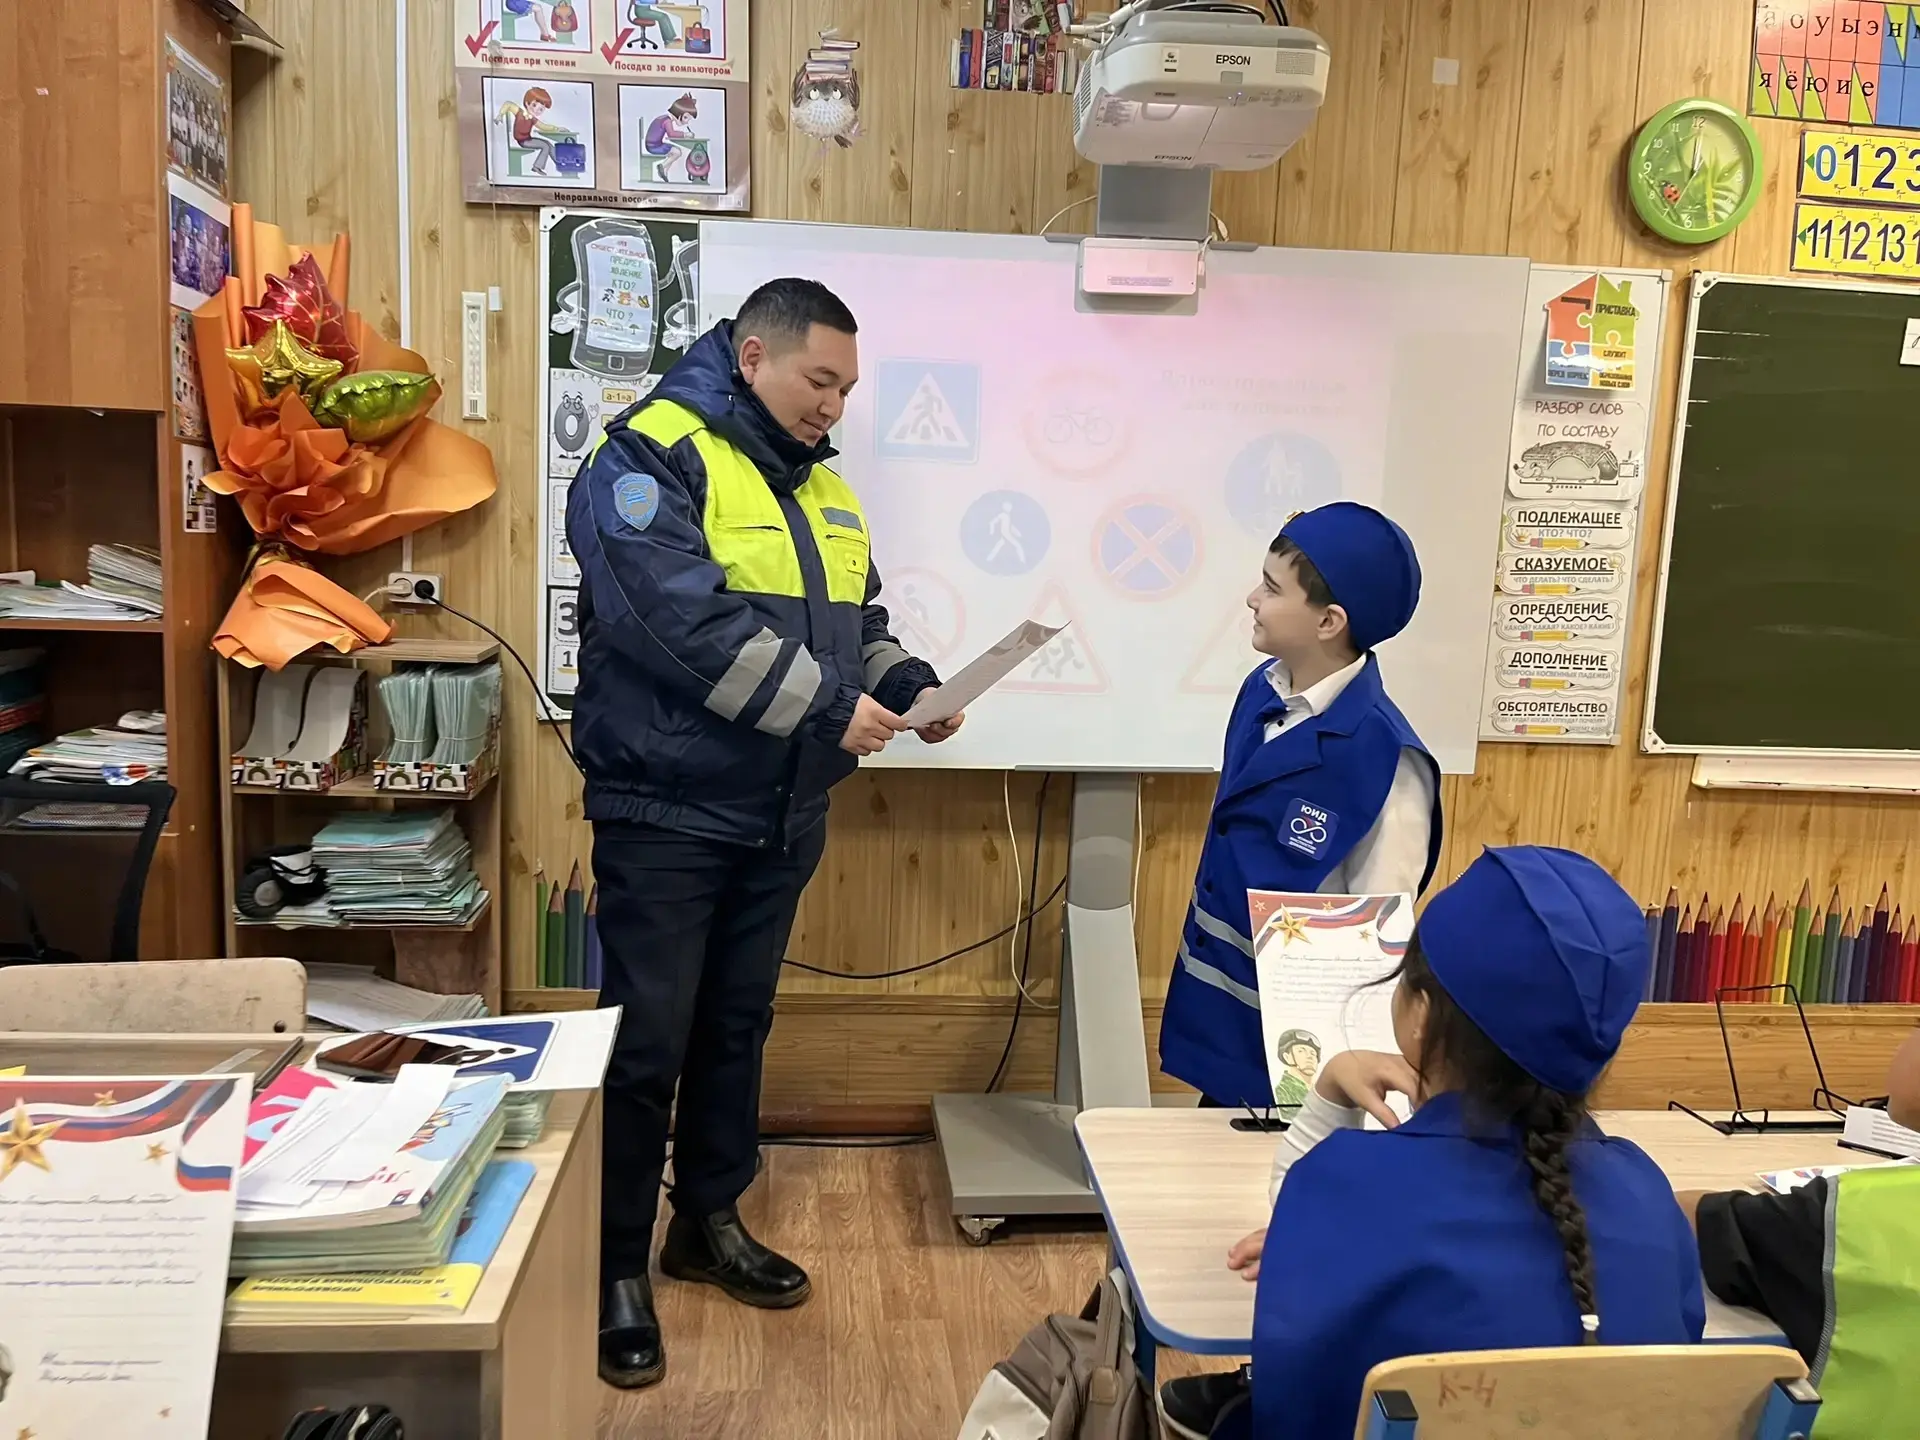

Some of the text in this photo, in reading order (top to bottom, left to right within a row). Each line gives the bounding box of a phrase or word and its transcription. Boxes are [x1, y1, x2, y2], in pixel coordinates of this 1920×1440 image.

[524, 57, 541, 67] при
[545, 58, 577, 67] чтении
[1216, 54, 1251, 66] EPSON
[615, 61, 731, 76] Посадка за компьютером
[1672, 123, 1679, 132] 11
[1692, 116, 1705, 128] 12
[1653, 138, 1663, 149] 10
[1643, 161, 1652, 176] 9
[1816, 144, 1837, 182] 0
[1844, 144, 1859, 187] 1
[1872, 146, 1897, 190] 2
[554, 191, 618, 203] Неправильная
[1806, 218, 1833, 259] 11
[1839, 220, 1871, 261] 12
[1877, 223, 1906, 263] 13
[612, 280, 636, 291] КТО?
[606, 308, 625, 320] ЧТО
[1595, 303, 1636, 317] ПРИСТАВКА
[1535, 401, 1624, 415] РАЗБОР СЛОВ
[1537, 424, 1619, 439] ПО СОСТАВУ
[1518, 511, 1621, 527] ПОДЛЕЖАЩЕЕ
[1538, 528, 1593, 538] КТО? ЧТО?
[1515, 557, 1607, 570] СКАЗУЕМОЕ
[1529, 576, 1560, 584] ДЕЛАТЬ?
[1577, 576, 1613, 584] СДЕЛАТЬ?
[1510, 603, 1609, 617] ОПРЕДЕЛЕНИЕ
[1511, 652, 1607, 666] ДОПОЛНЕНИЕ
[1498, 702, 1608, 713] ОБСТОЯТЕЛЬСТВО
[1301, 804, 1327, 823] ЮИД
